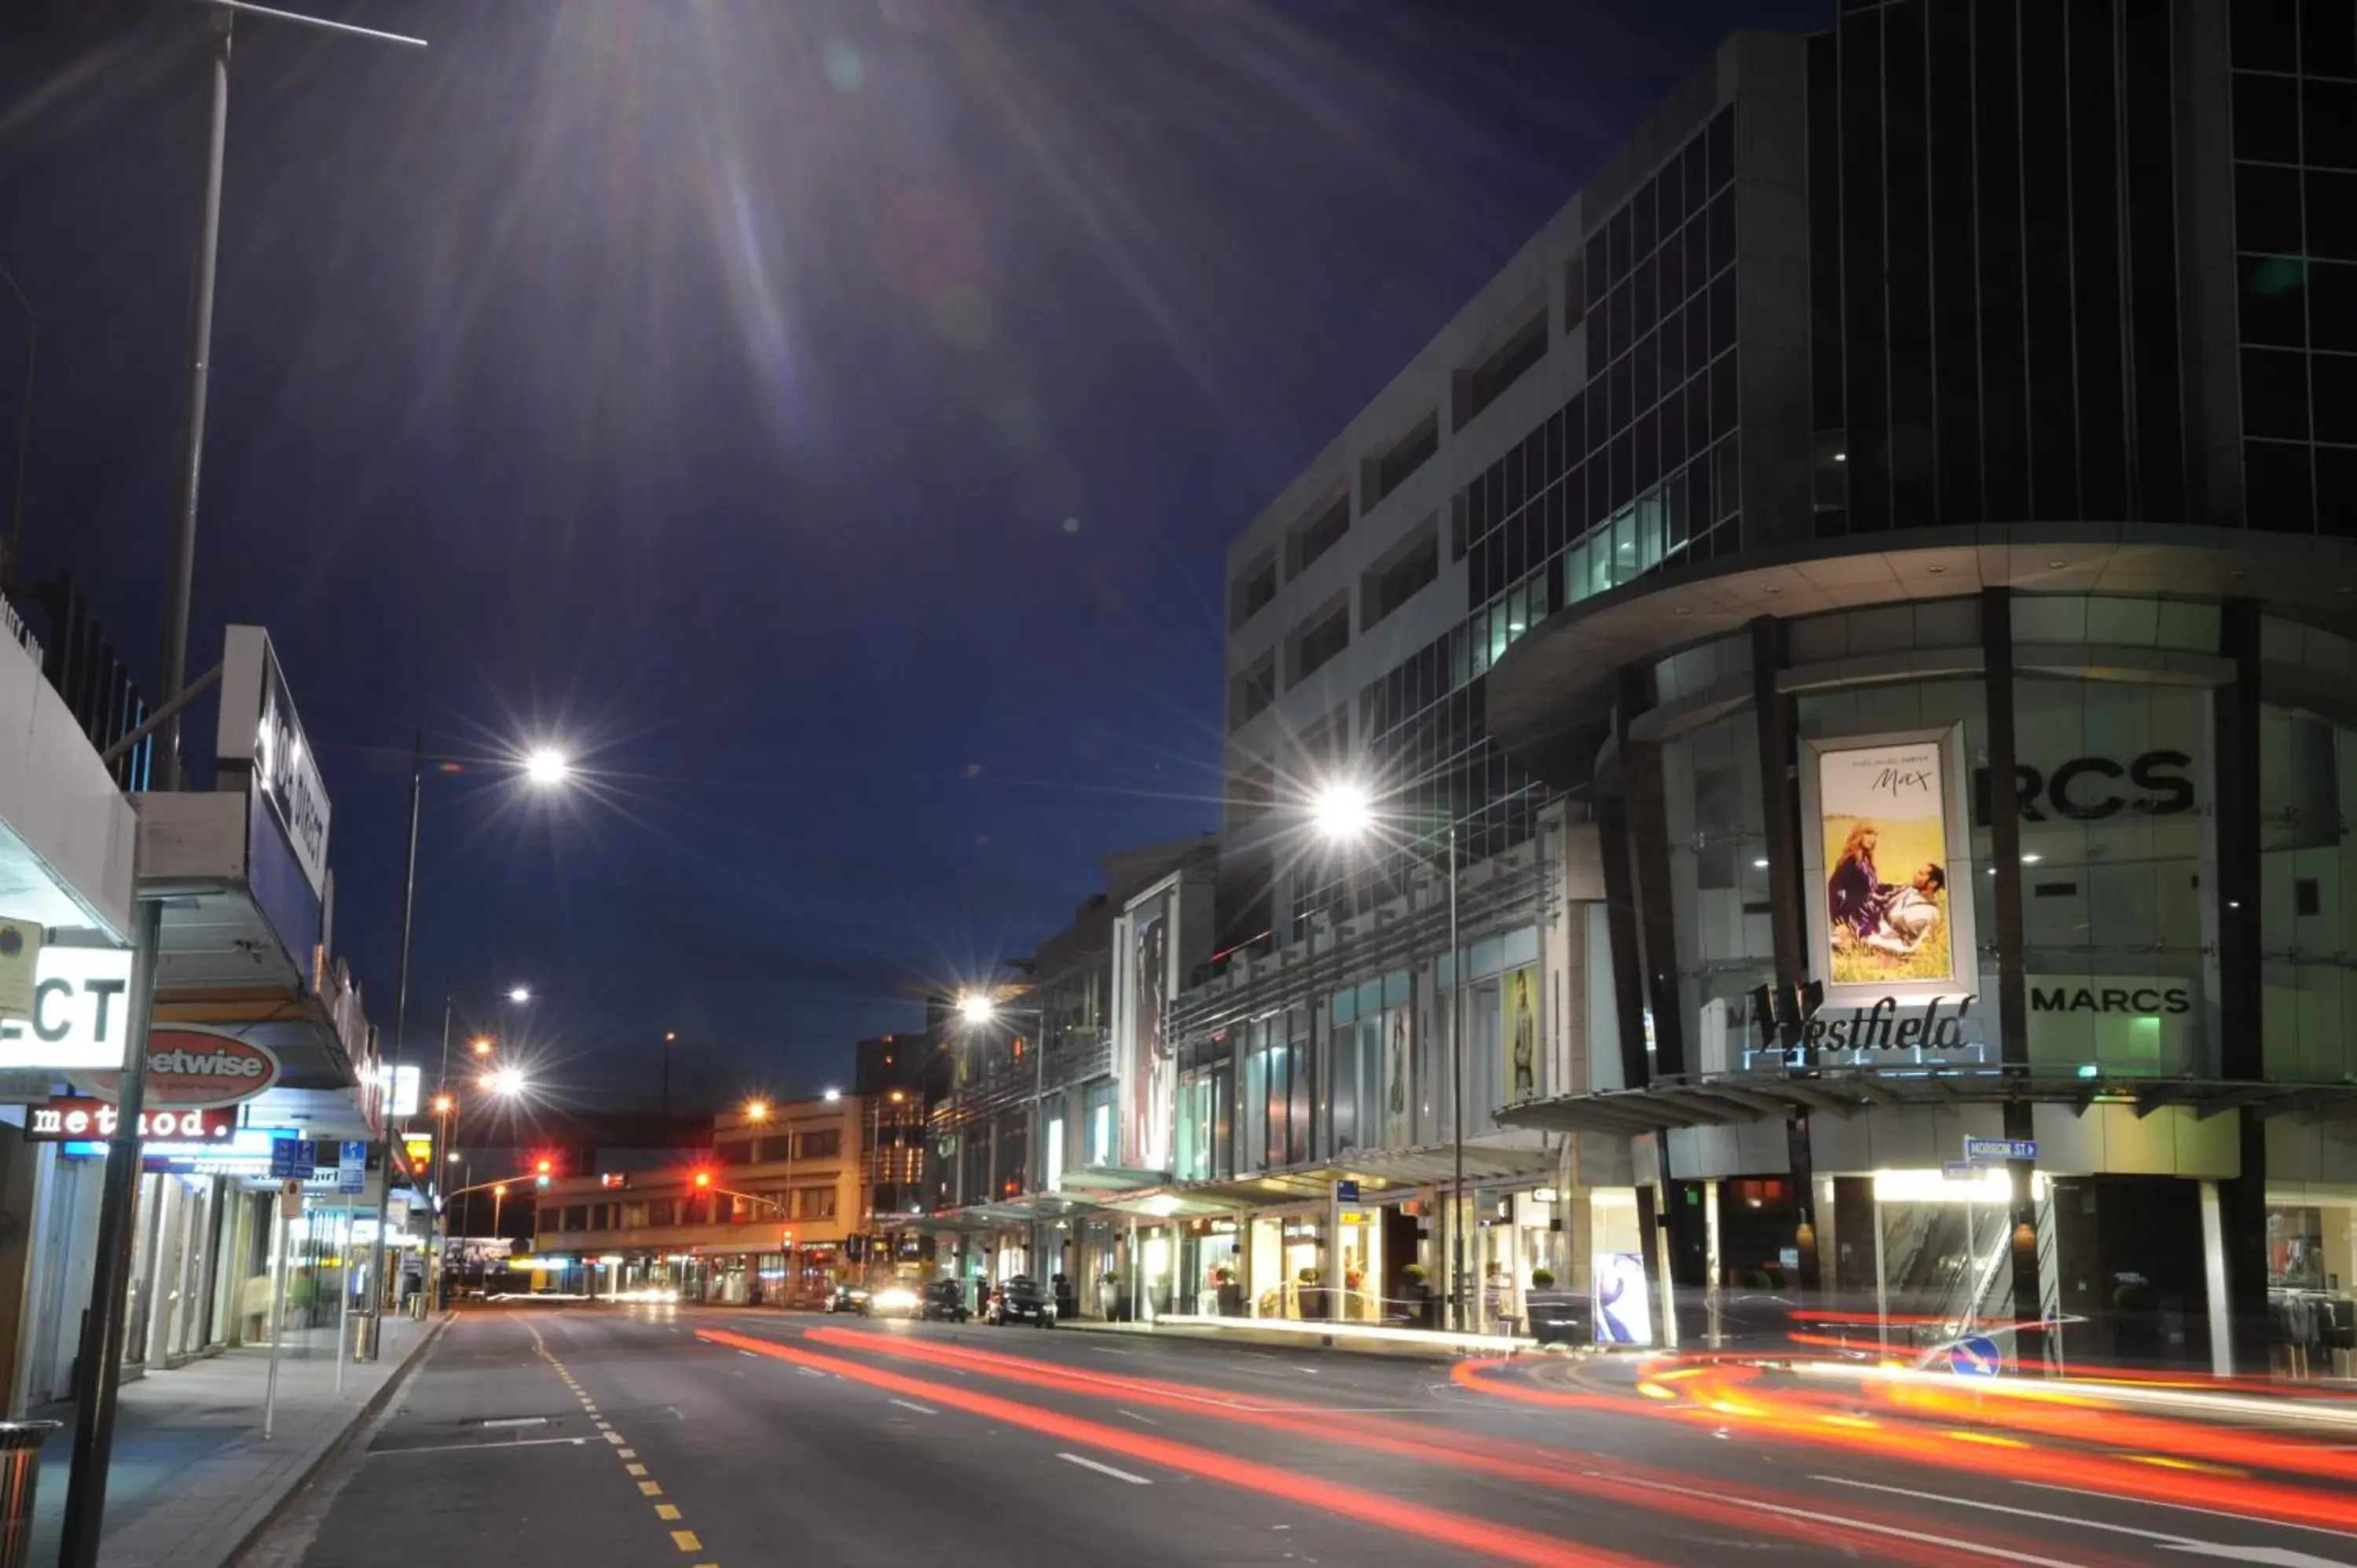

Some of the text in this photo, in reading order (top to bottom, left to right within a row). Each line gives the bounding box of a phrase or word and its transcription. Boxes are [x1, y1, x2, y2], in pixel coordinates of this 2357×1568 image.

[1871, 767, 1932, 797] Max
[0, 977, 126, 1043] CT
[2031, 987, 2191, 1014] MARCS
[1747, 980, 1978, 1057] Westfield
[147, 1047, 263, 1077] etwise
[2014, 1143, 2025, 1156] ST
